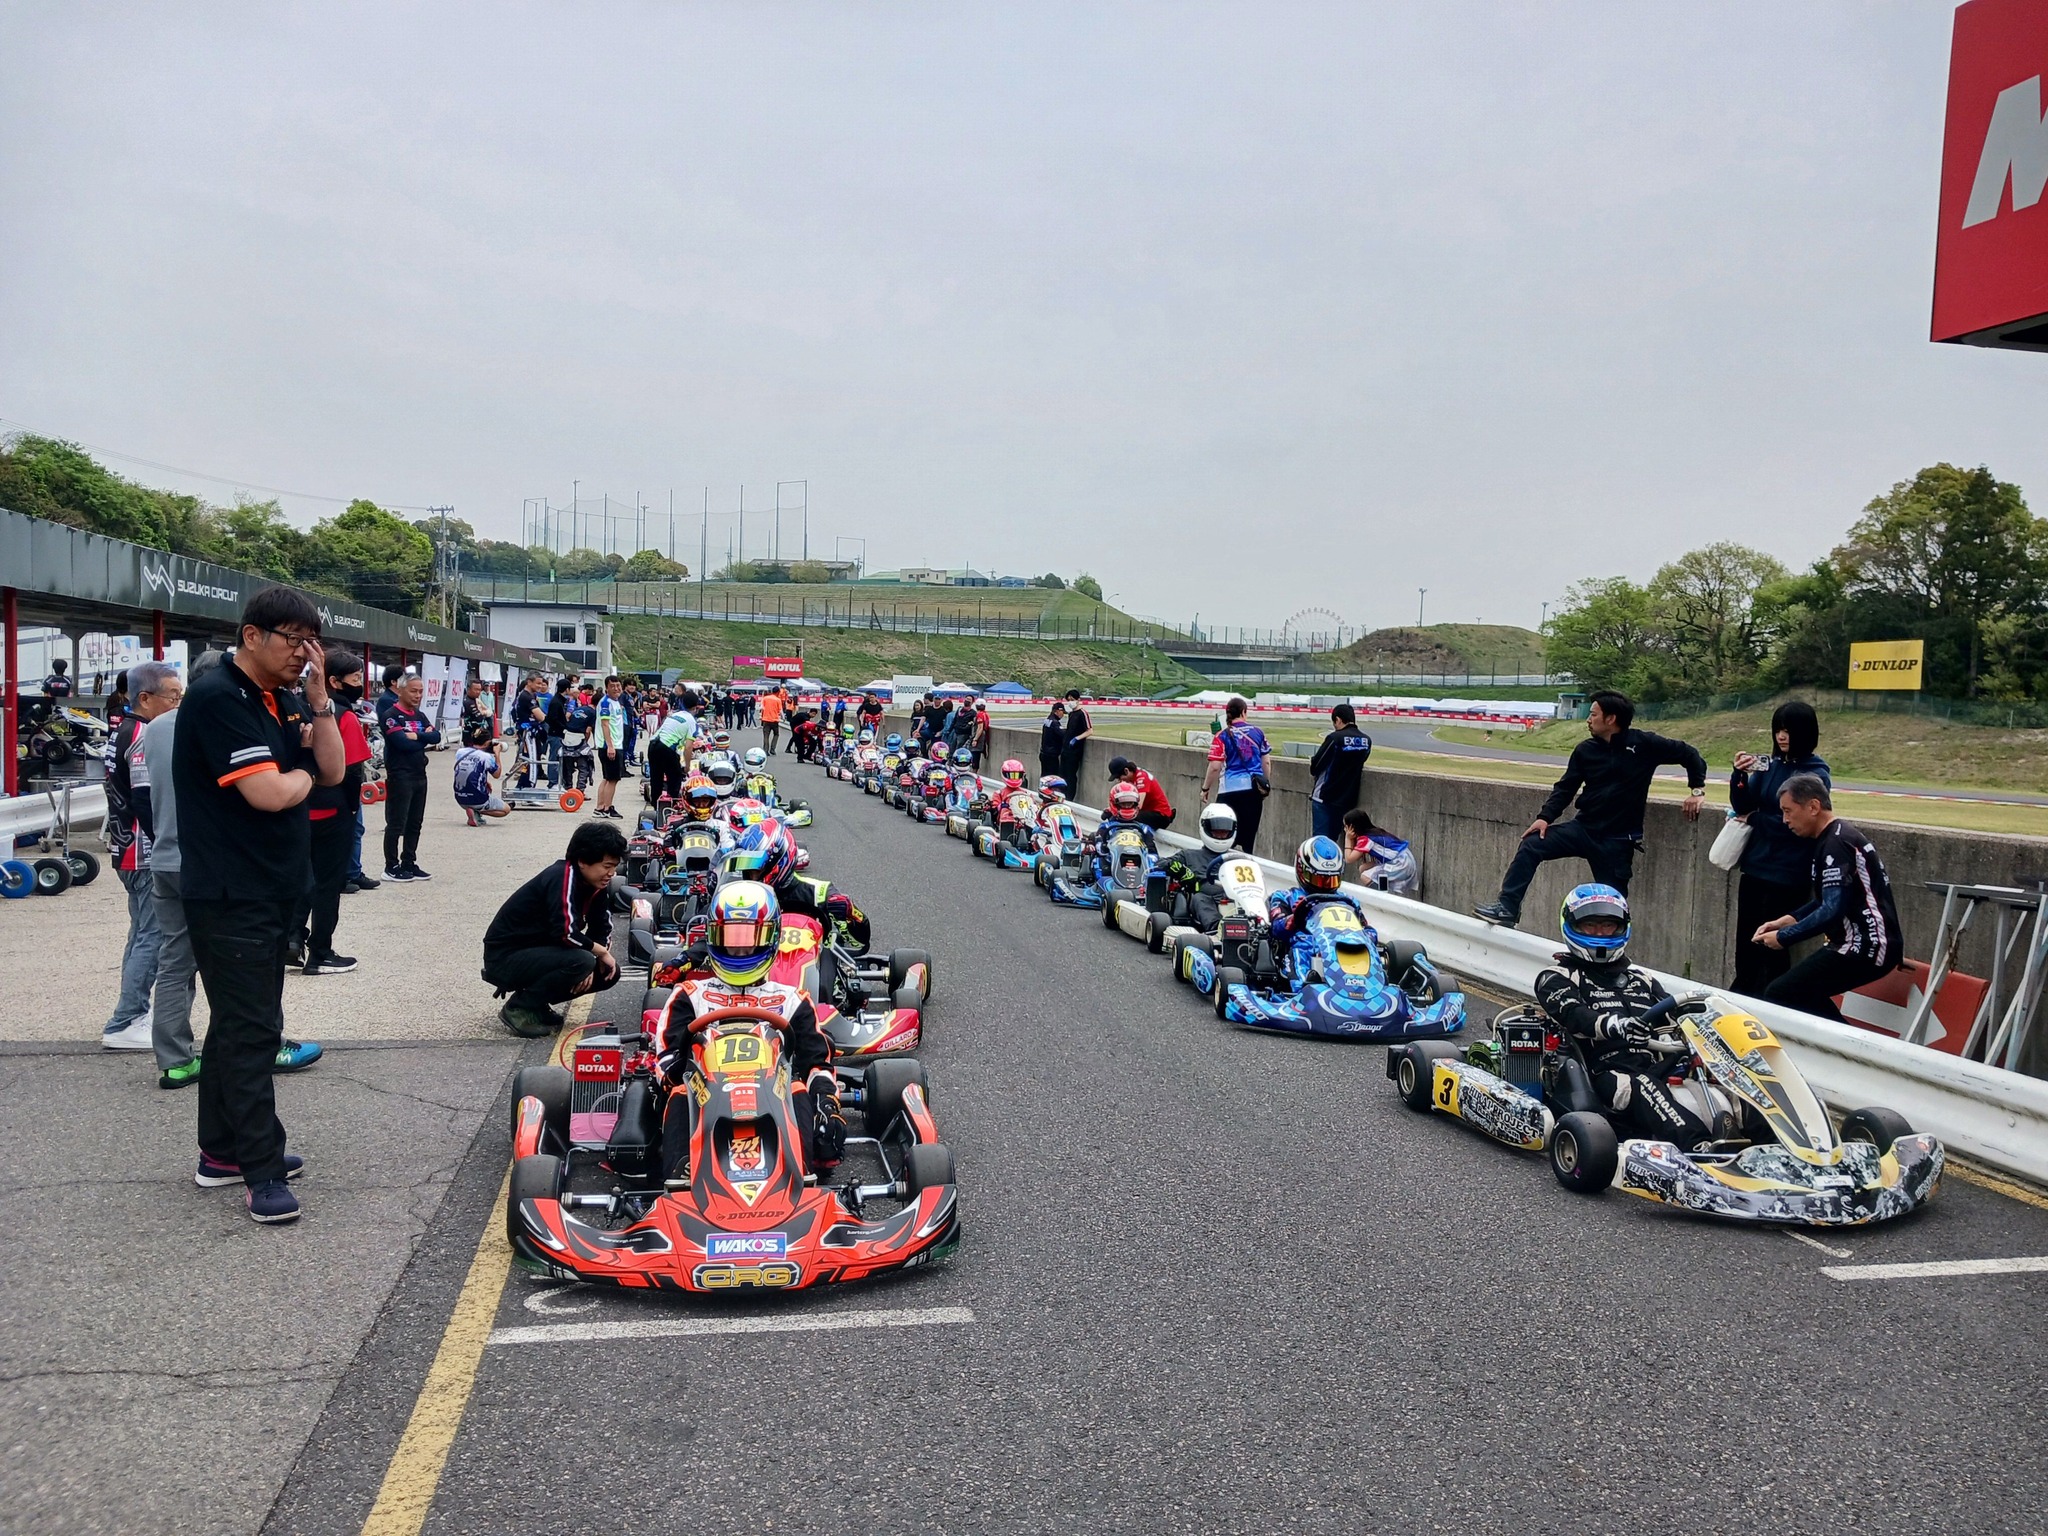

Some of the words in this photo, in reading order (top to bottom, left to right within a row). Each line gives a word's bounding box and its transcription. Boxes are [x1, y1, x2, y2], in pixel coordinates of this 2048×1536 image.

[177, 579, 210, 597] SUZUKA
[211, 587, 238, 603] CIRCUIT
[334, 614, 350, 627] SUZUKA
[351, 619, 365, 630] CIRCUIT
[767, 663, 801, 672] MOTUL
[1861, 659, 1918, 671] DUNLOP
[895, 684, 931, 694] BRIDGESTONE
[686, 838, 710, 848] 10
[1234, 865, 1256, 883] 33
[1328, 909, 1354, 923] 17
[702, 991, 787, 1008] CRG
[1599, 1001, 1624, 1009] YAMAHA
[1353, 1021, 1383, 1032] Drago
[1742, 1019, 1768, 1041] 3
[884, 1031, 912, 1049] GILLARD
[1510, 1040, 1540, 1048] ROTAX
[721, 1037, 761, 1065] 19
[577, 1064, 615, 1073] ROTAX
[1439, 1077, 1455, 1106] 3
[1468, 1085, 1493, 1110] HIRAI
[1491, 1103, 1540, 1139] PROJECT
[1653, 1090, 1686, 1127] PROJECT
[727, 1210, 785, 1221] DUNLOP
[701, 1267, 791, 1288] CRG
